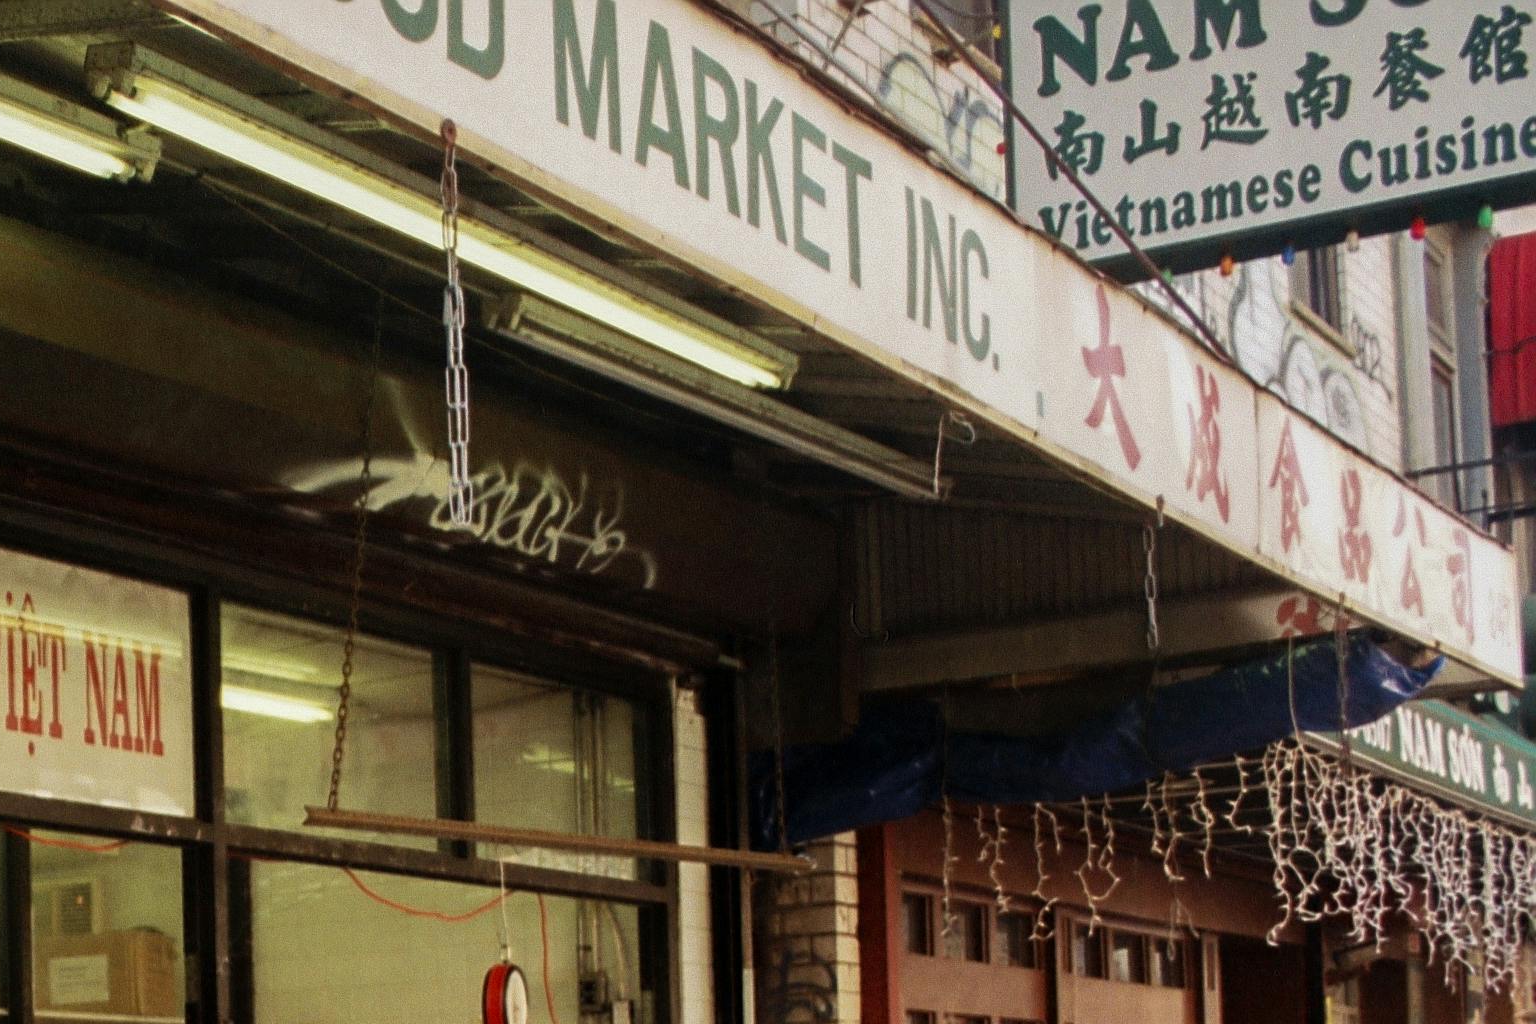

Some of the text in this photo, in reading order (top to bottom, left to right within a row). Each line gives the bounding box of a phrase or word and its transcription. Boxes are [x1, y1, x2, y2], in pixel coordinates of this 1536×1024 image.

[1033, 0, 1267, 98] NAM
[1044, 5, 1533, 181] 南山越南餐館
[554, 0, 872, 290] MARKET
[906, 185, 1000, 372] INC.
[1038, 113, 1536, 251] Vietnamese Cuisine
[83, 629, 164, 758] NAM
